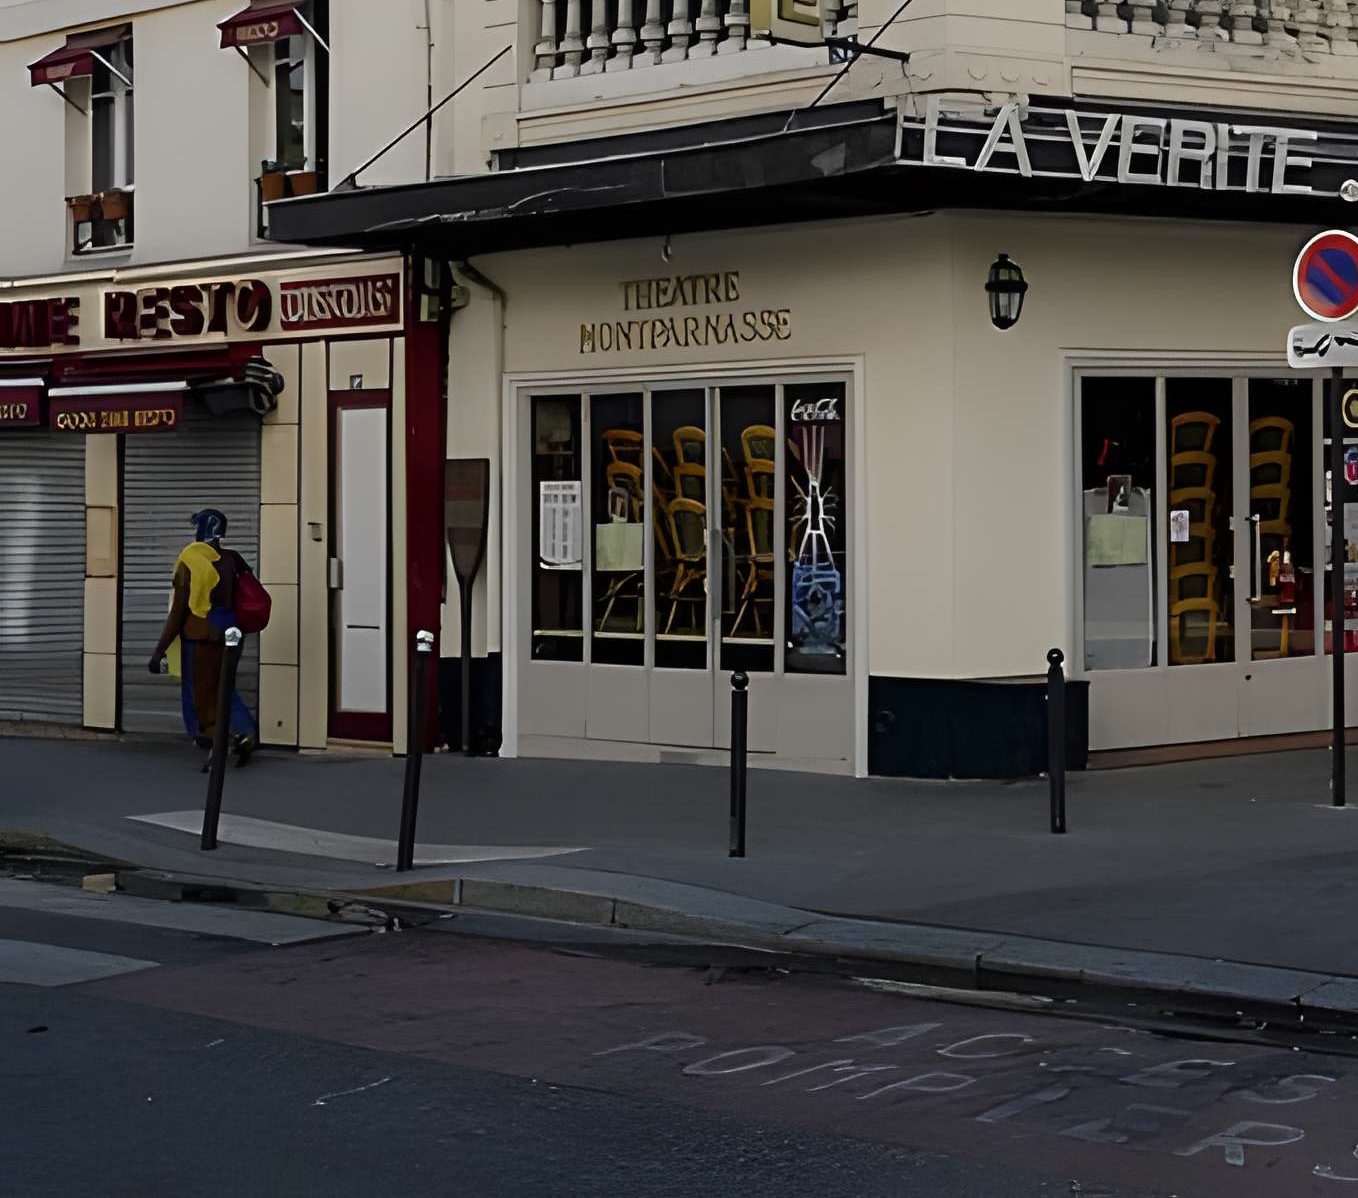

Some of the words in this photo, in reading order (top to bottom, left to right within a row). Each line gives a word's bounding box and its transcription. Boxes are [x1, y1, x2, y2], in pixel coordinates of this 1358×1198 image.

[923, 99, 1032, 177] LA
[1065, 110, 1318, 193] VERITE
[104, 279, 273, 339] RESTO
[619, 271, 740, 311] THEATRE
[580, 309, 791, 353] MONTPARNASSE
[833, 1022, 1337, 1105] ACES
